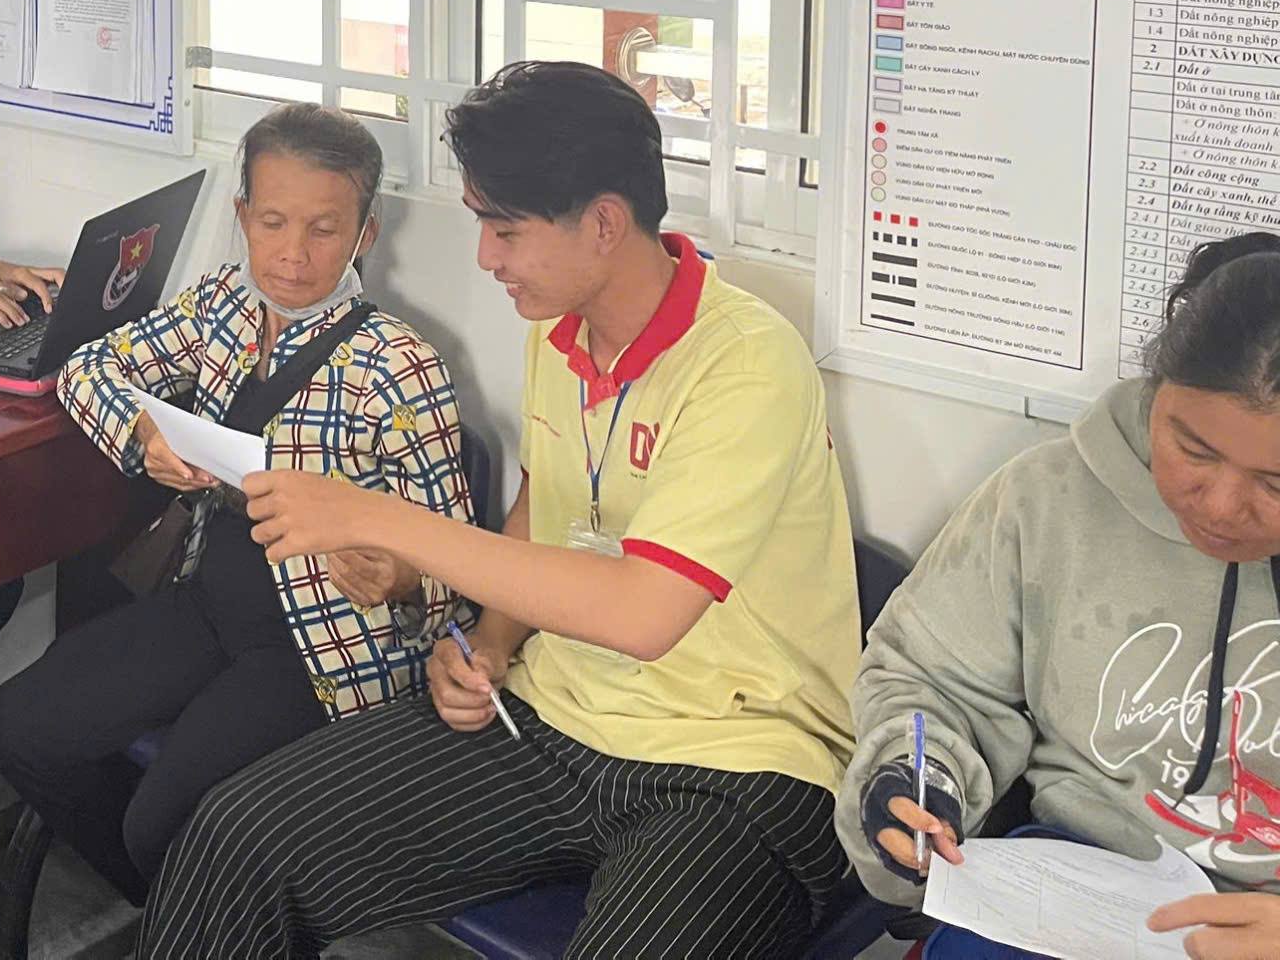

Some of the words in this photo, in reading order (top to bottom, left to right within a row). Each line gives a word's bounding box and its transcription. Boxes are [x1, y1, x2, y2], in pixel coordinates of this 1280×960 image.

[1148, 8, 1164, 18] 1.3
[1179, 8, 1200, 21] Đất
[1203, 11, 1234, 25] nông
[1237, 15, 1279, 28] nghiệp
[1147, 25, 1163, 35] 1.4
[1179, 27, 1199, 39] Đất
[1202, 29, 1233, 43] nông
[1236, 33, 1278, 46] nghiệp
[1150, 44, 1157, 53] 2
[1178, 44, 1208, 57] ĐẤT
[1209, 46, 1241, 61] XÂY
[1142, 61, 1161, 71] 2.1
[1177, 63, 1200, 76] Đất
[1176, 80, 1196, 92] Đất
[1211, 85, 1226, 96] tại
[1229, 86, 1261, 101] trung
[1175, 98, 1196, 111] Đất
[1210, 103, 1241, 117] nông
[1208, 121, 1239, 134] nông
[1241, 122, 1270, 136] thôn
[1174, 131, 1201, 143] xuất
[1204, 135, 1231, 147] kinh
[1234, 140, 1273, 151] doanh
[1206, 152, 1237, 165] nông
[1240, 154, 1268, 168] thôn
[1138, 161, 1157, 171] 2.2
[1173, 164, 1195, 177] Đất
[1197, 168, 1227, 183] công
[1230, 172, 1260, 187] cộng
[1138, 178, 1156, 188] 2.3
[1172, 182, 1194, 195] Đất
[1197, 186, 1216, 199] cây
[1137, 196, 1155, 206] 2.4
[1171, 199, 1193, 212] Đất
[1195, 202, 1210, 216] hạ
[1214, 203, 1242, 220] tầng
[1244, 211, 1259, 224] kỹ
[1131, 211, 1159, 224] 2.4.1
[1170, 216, 1192, 229] Đất
[1193, 221, 1222, 235] giao
[1130, 229, 1159, 242] 2.4.2
[1129, 247, 1158, 259] 2.4.3
[1129, 264, 1157, 276] 2.4.4
[1133, 299, 1150, 309] 2.5
[1132, 317, 1149, 327] 2.6
